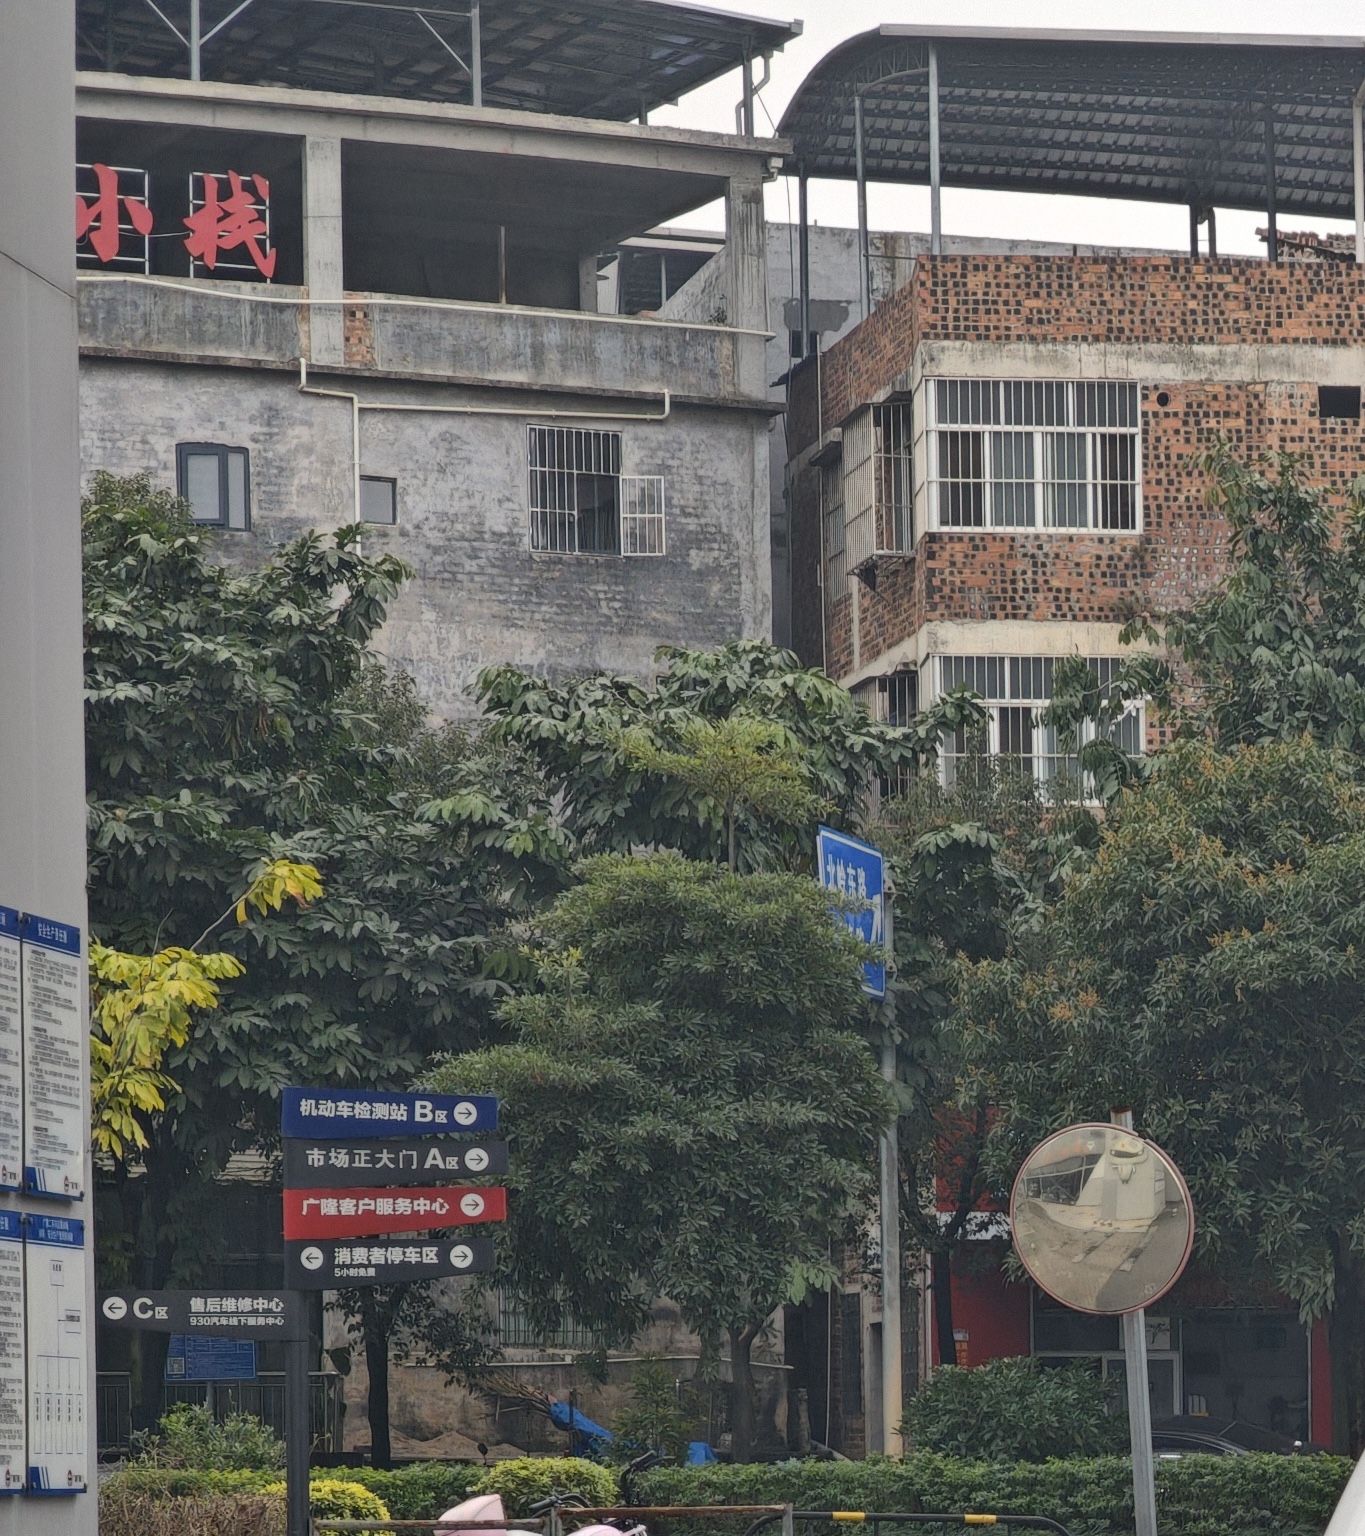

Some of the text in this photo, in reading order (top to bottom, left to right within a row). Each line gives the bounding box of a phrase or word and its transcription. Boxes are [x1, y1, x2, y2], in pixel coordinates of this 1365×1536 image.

[299, 1098, 448, 1124] 机动车检测站 B区
[305, 1147, 459, 1170] 市场正大门 A区
[301, 1197, 450, 1216] 广隆客户服务中心
[333, 1246, 439, 1265] 消费者停车区
[334, 1267, 376, 1277] 5小时免费
[132, 1296, 285, 1320] C区 售后维修中心
